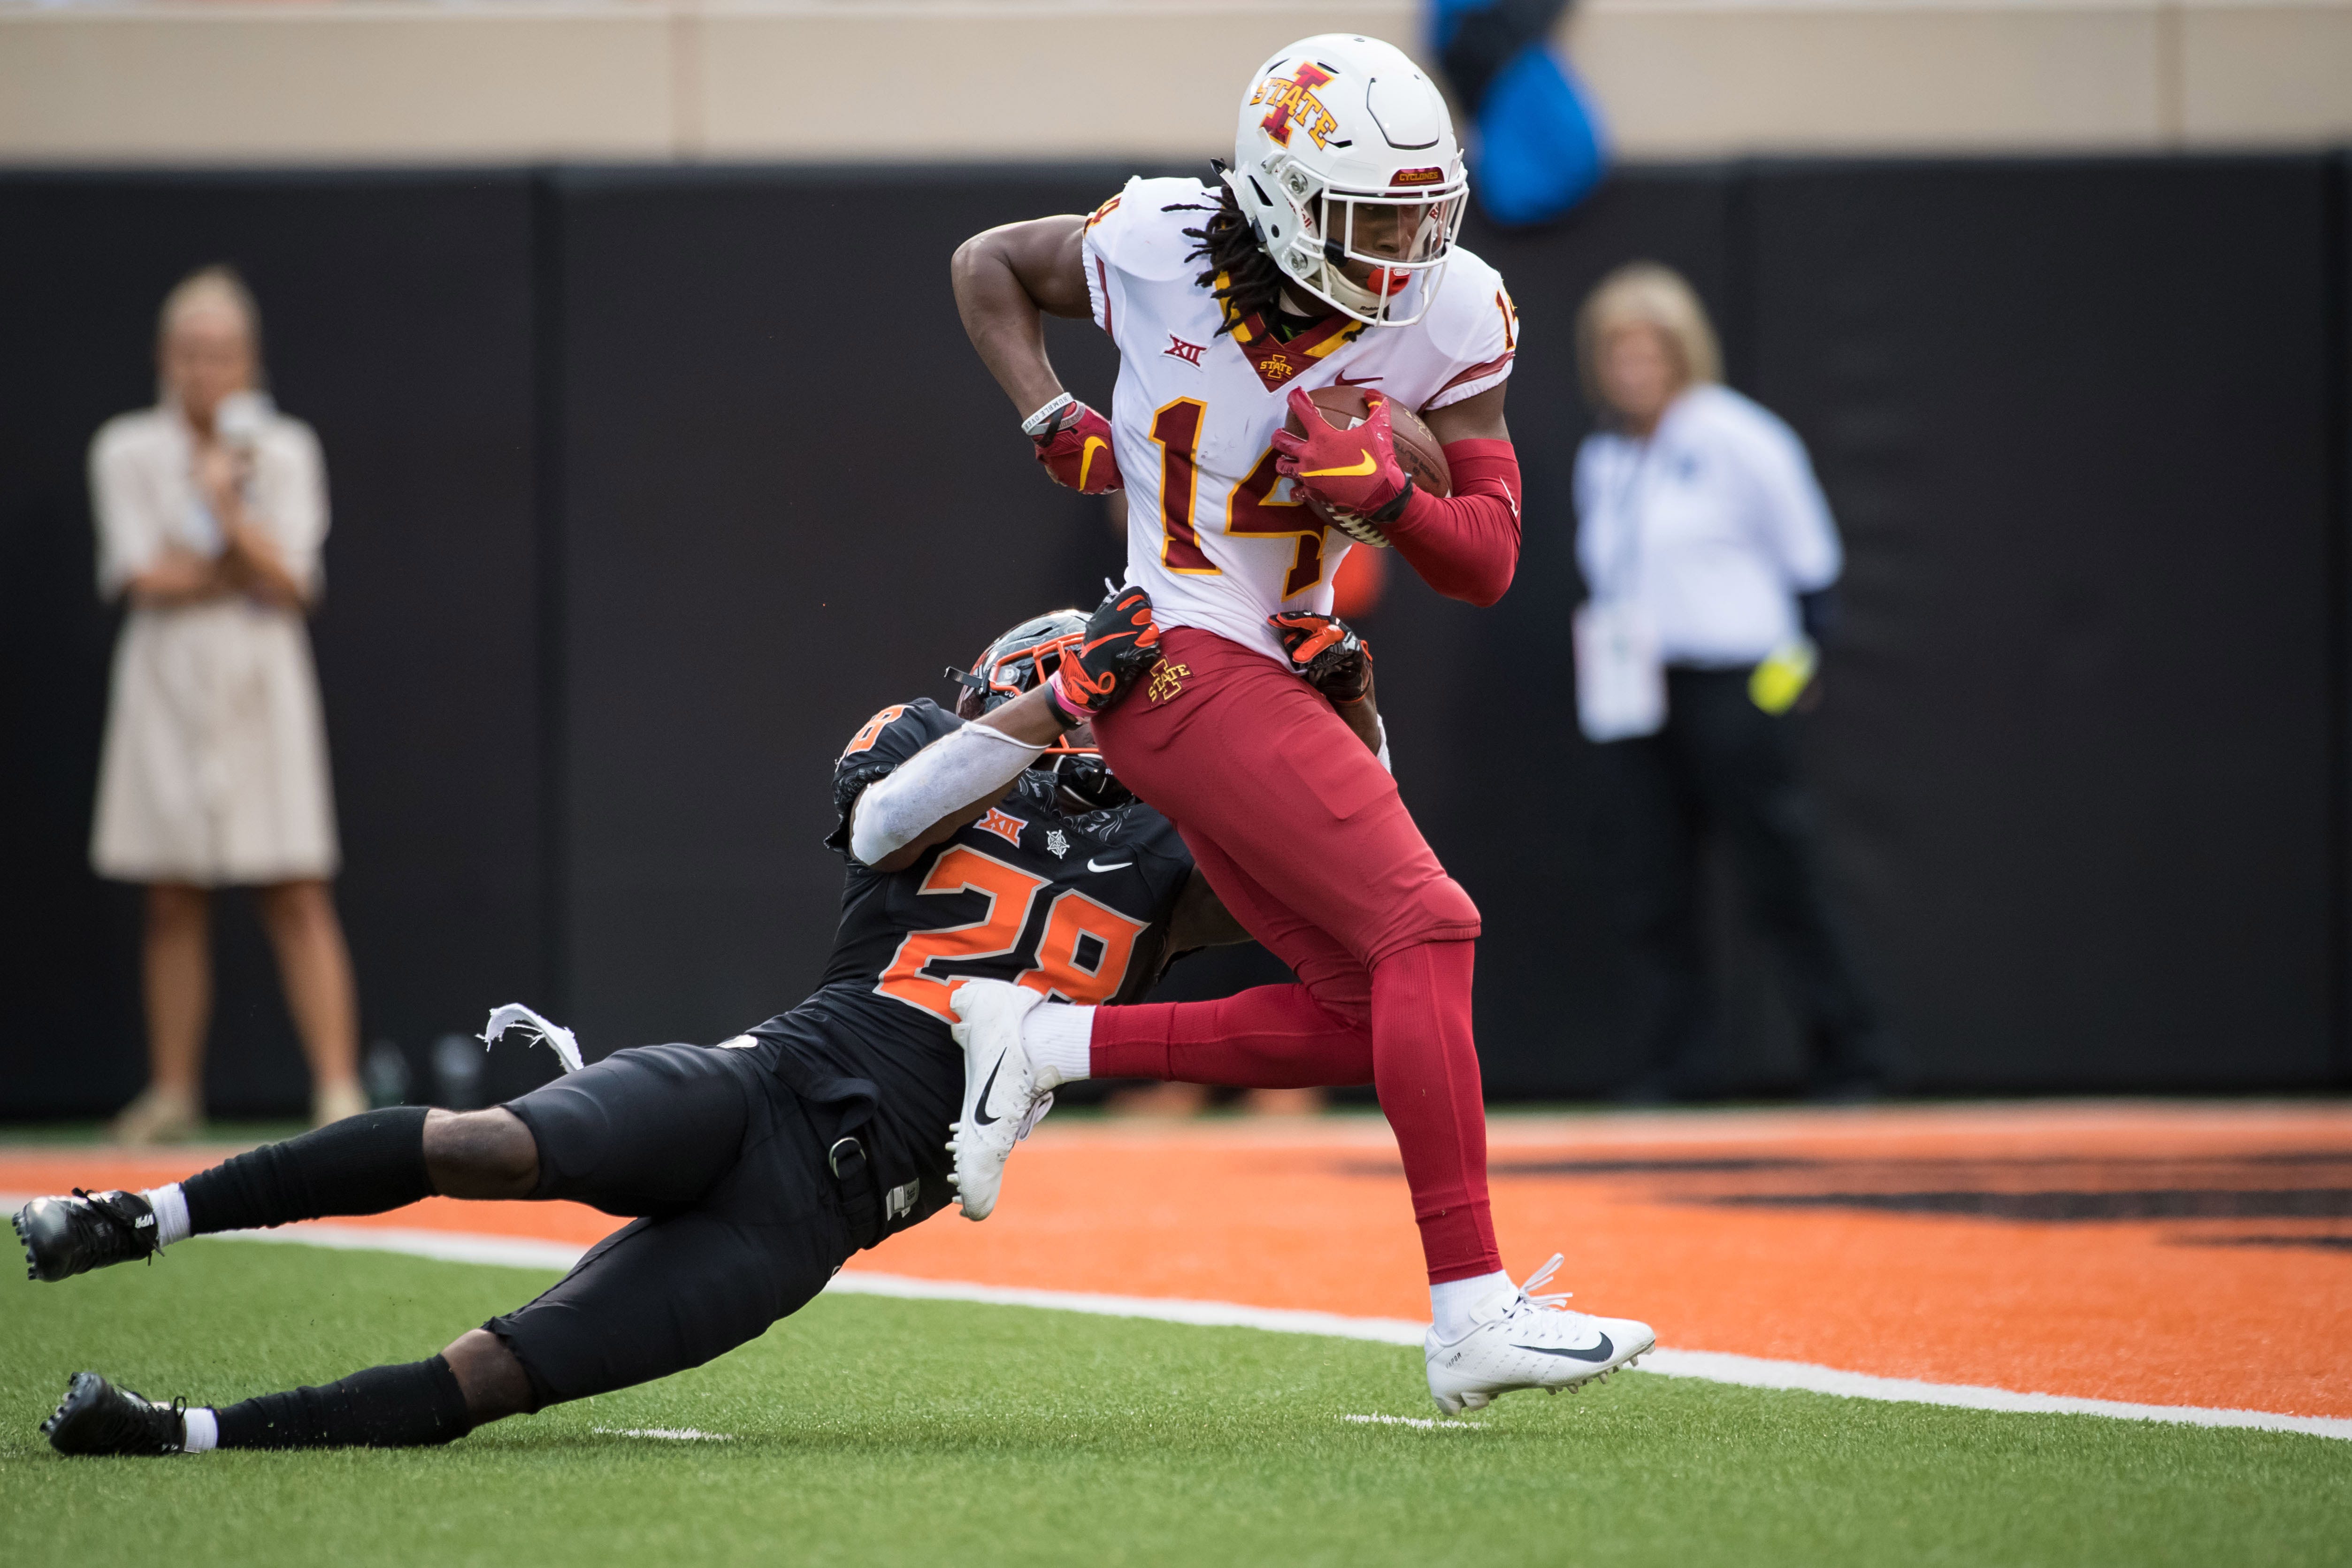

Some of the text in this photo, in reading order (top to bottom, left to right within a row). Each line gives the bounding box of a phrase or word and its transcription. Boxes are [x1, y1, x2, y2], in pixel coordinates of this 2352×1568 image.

[1249, 77, 1339, 151] STATE
[1399, 172, 1438, 181] CYCLONES
[1163, 333, 1208, 368] XII
[1260, 361, 1293, 375] STATE
[1024, 396, 1069, 430] HUMBLE OVER
[1148, 396, 1331, 603] 14
[1148, 664, 1191, 703] STATE
[840, 704, 915, 763] 8
[975, 807, 1027, 847] XII
[872, 843, 1151, 1025] 28
